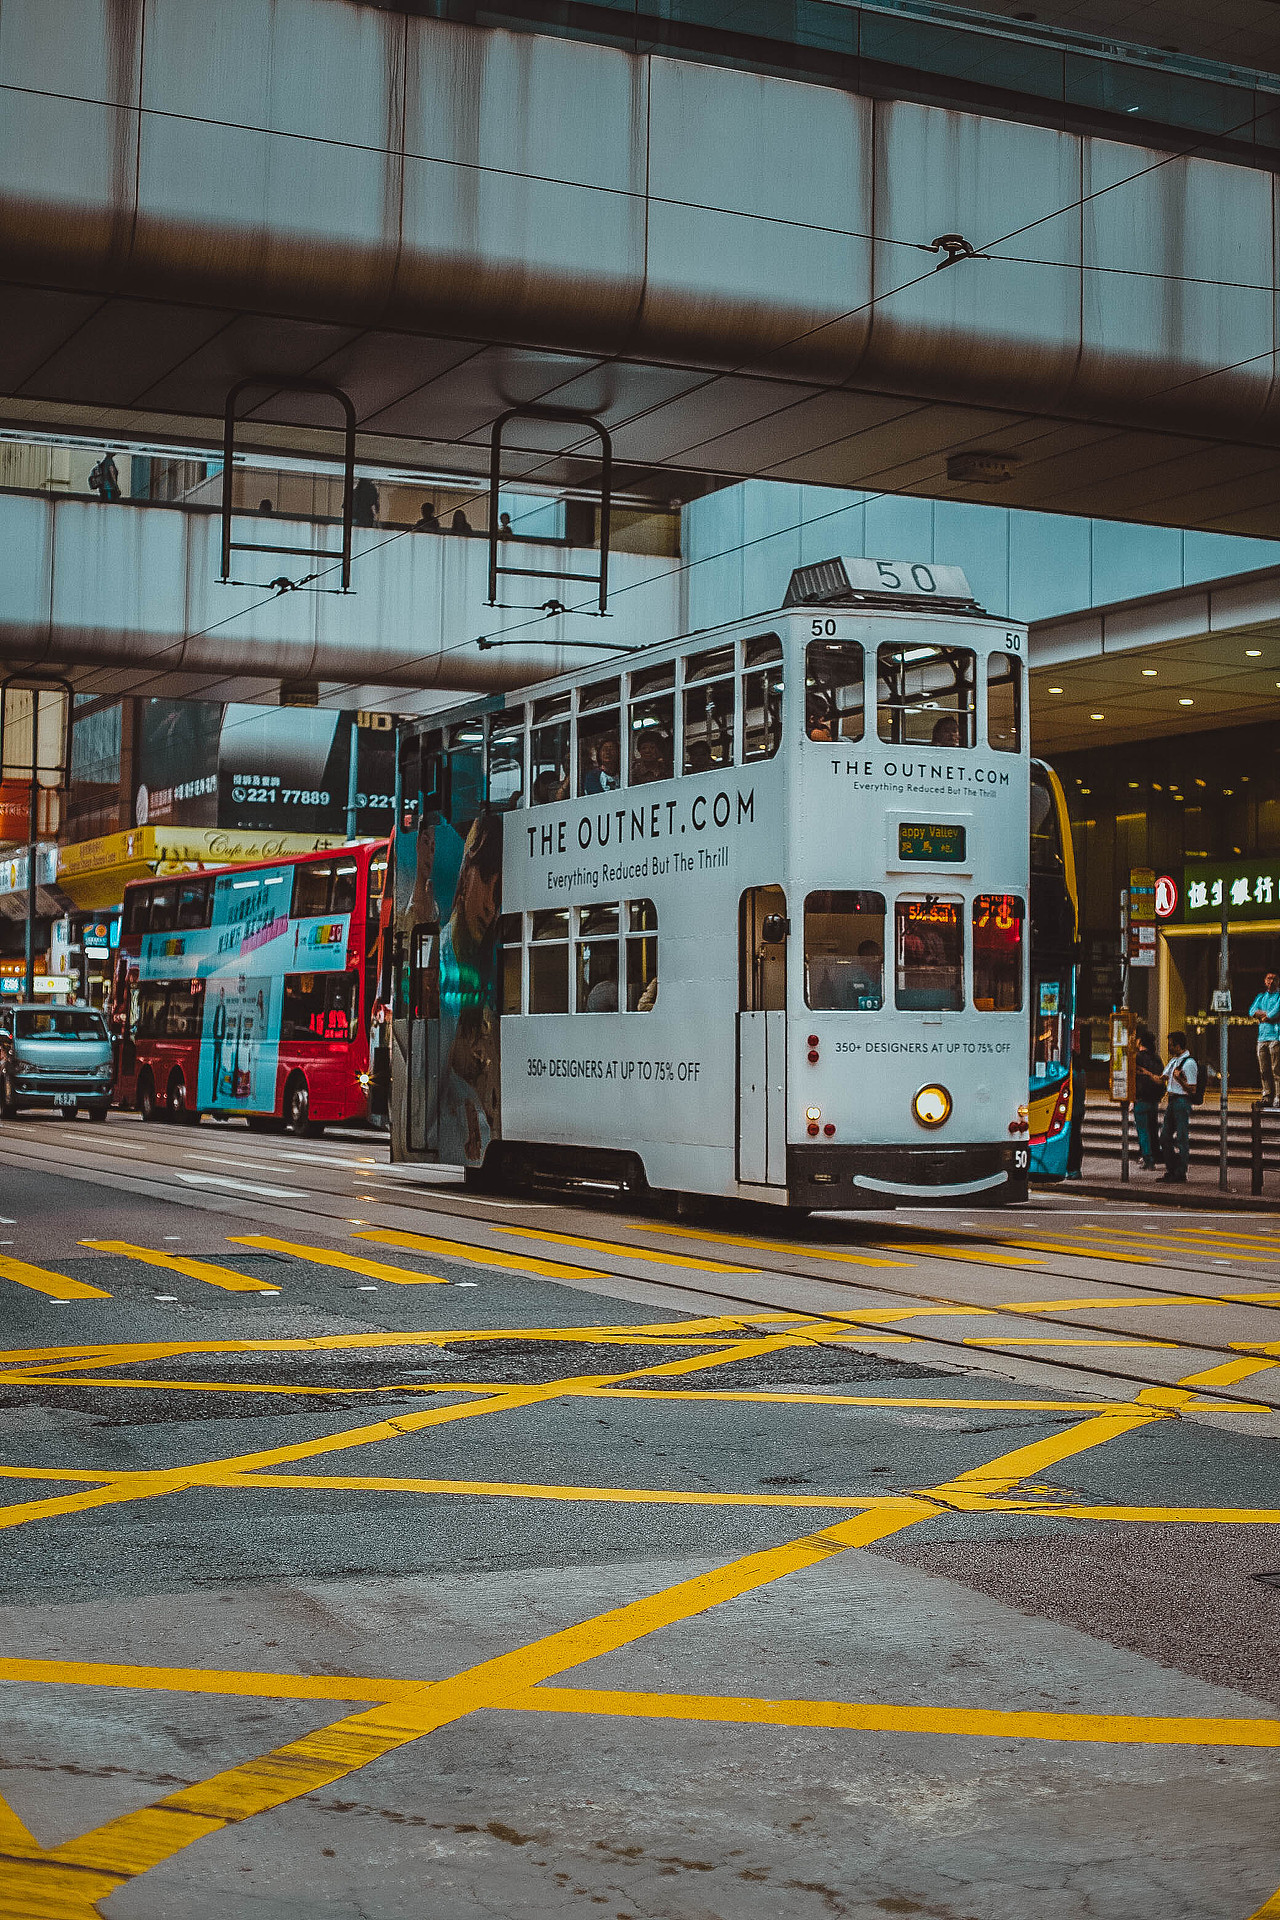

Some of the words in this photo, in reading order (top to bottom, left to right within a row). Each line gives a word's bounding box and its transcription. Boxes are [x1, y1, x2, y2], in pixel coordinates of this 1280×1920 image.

[876, 561, 937, 593] 50
[811, 618, 837, 637] 50
[1006, 632, 1021, 650] 50
[832, 760, 873, 775] THE
[884, 762, 1010, 785] OUTNET.COM
[247, 788, 276, 804] 221
[853, 781, 904, 794] Everything
[907, 783, 946, 795] Reduced
[948, 786, 961, 796] But
[963, 787, 978, 798] The
[979, 789, 998, 799] Thrill
[527, 821, 567, 858] THE
[577, 788, 755, 847] OUTNET.COM
[901, 827, 926, 840] appy
[547, 868, 599, 891] Everything
[602, 857, 648, 881] Reduced
[652, 856, 670, 876] But
[673, 850, 695, 873] The
[698, 846, 729, 870] Thrill
[835, 1043, 862, 1054] 350+
[865, 1043, 928, 1054] DESIGNERS
[931, 1043, 944, 1055] AT
[947, 1043, 960, 1055] UP
[962, 1043, 976, 1055] TO
[977, 1043, 994, 1055] 75%
[995, 1043, 1011, 1055] OFF
[526, 1058, 547, 1077] 350+
[550, 1059, 602, 1079] DESIGNERS
[605, 1060, 618, 1080] AT
[620, 1061, 634, 1081] UP
[637, 1061, 652, 1081] TO
[654, 1061, 674, 1081] 75%
[677, 1062, 700, 1082] OFF
[1015, 1150, 1027, 1169] 50
